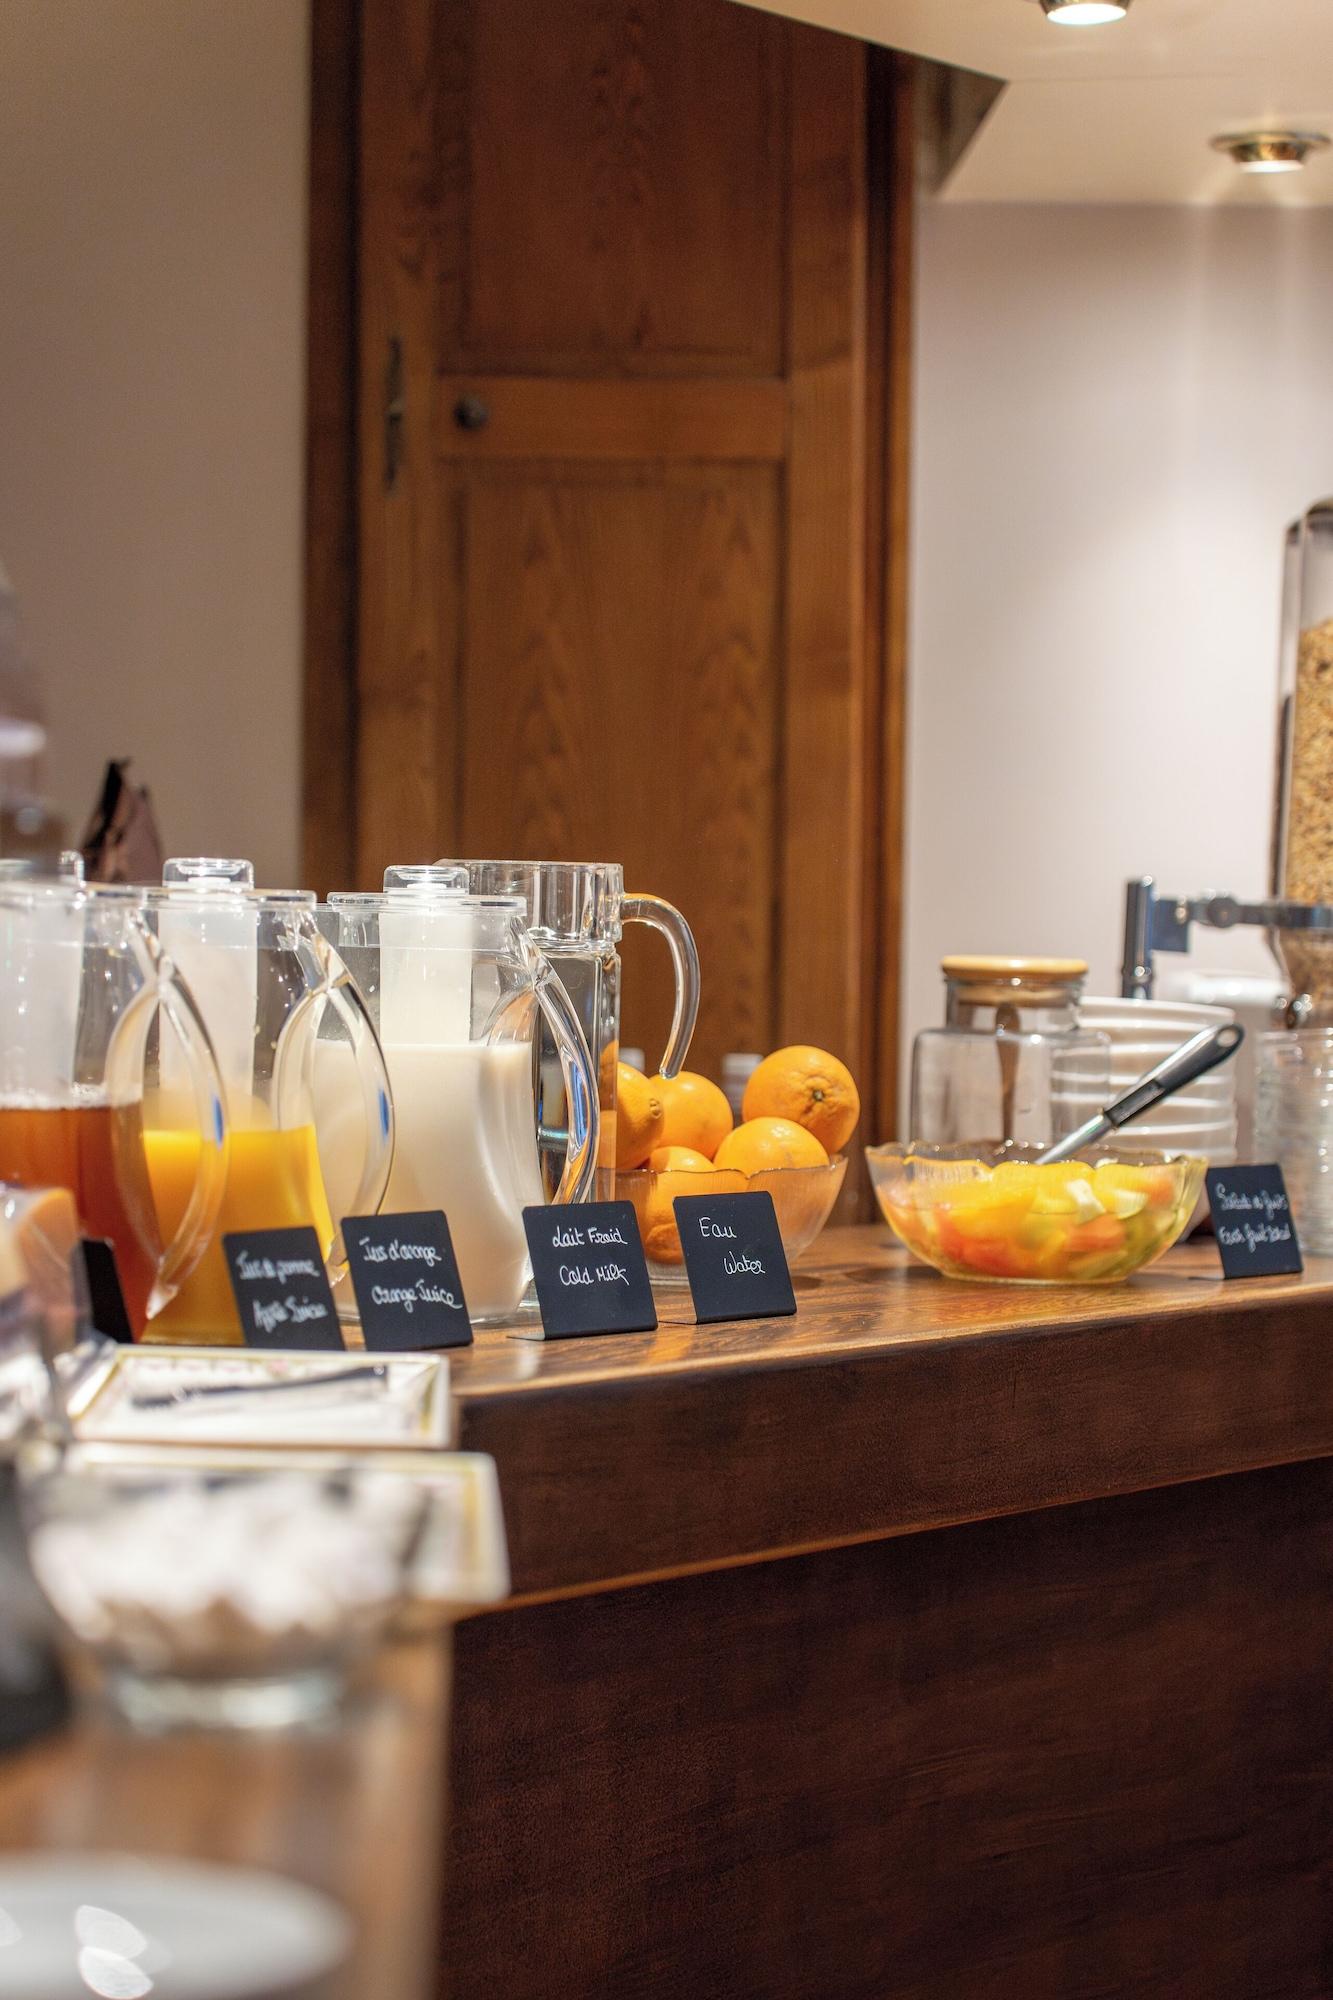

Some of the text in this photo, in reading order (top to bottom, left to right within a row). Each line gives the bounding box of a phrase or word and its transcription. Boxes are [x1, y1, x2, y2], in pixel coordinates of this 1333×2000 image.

[699, 1217, 737, 1238] Eau
[359, 1237, 388, 1262] Jus
[723, 1251, 766, 1274] Water
[560, 1264, 629, 1286] Cold Milk
[371, 1278, 463, 1313] Orange Juice
